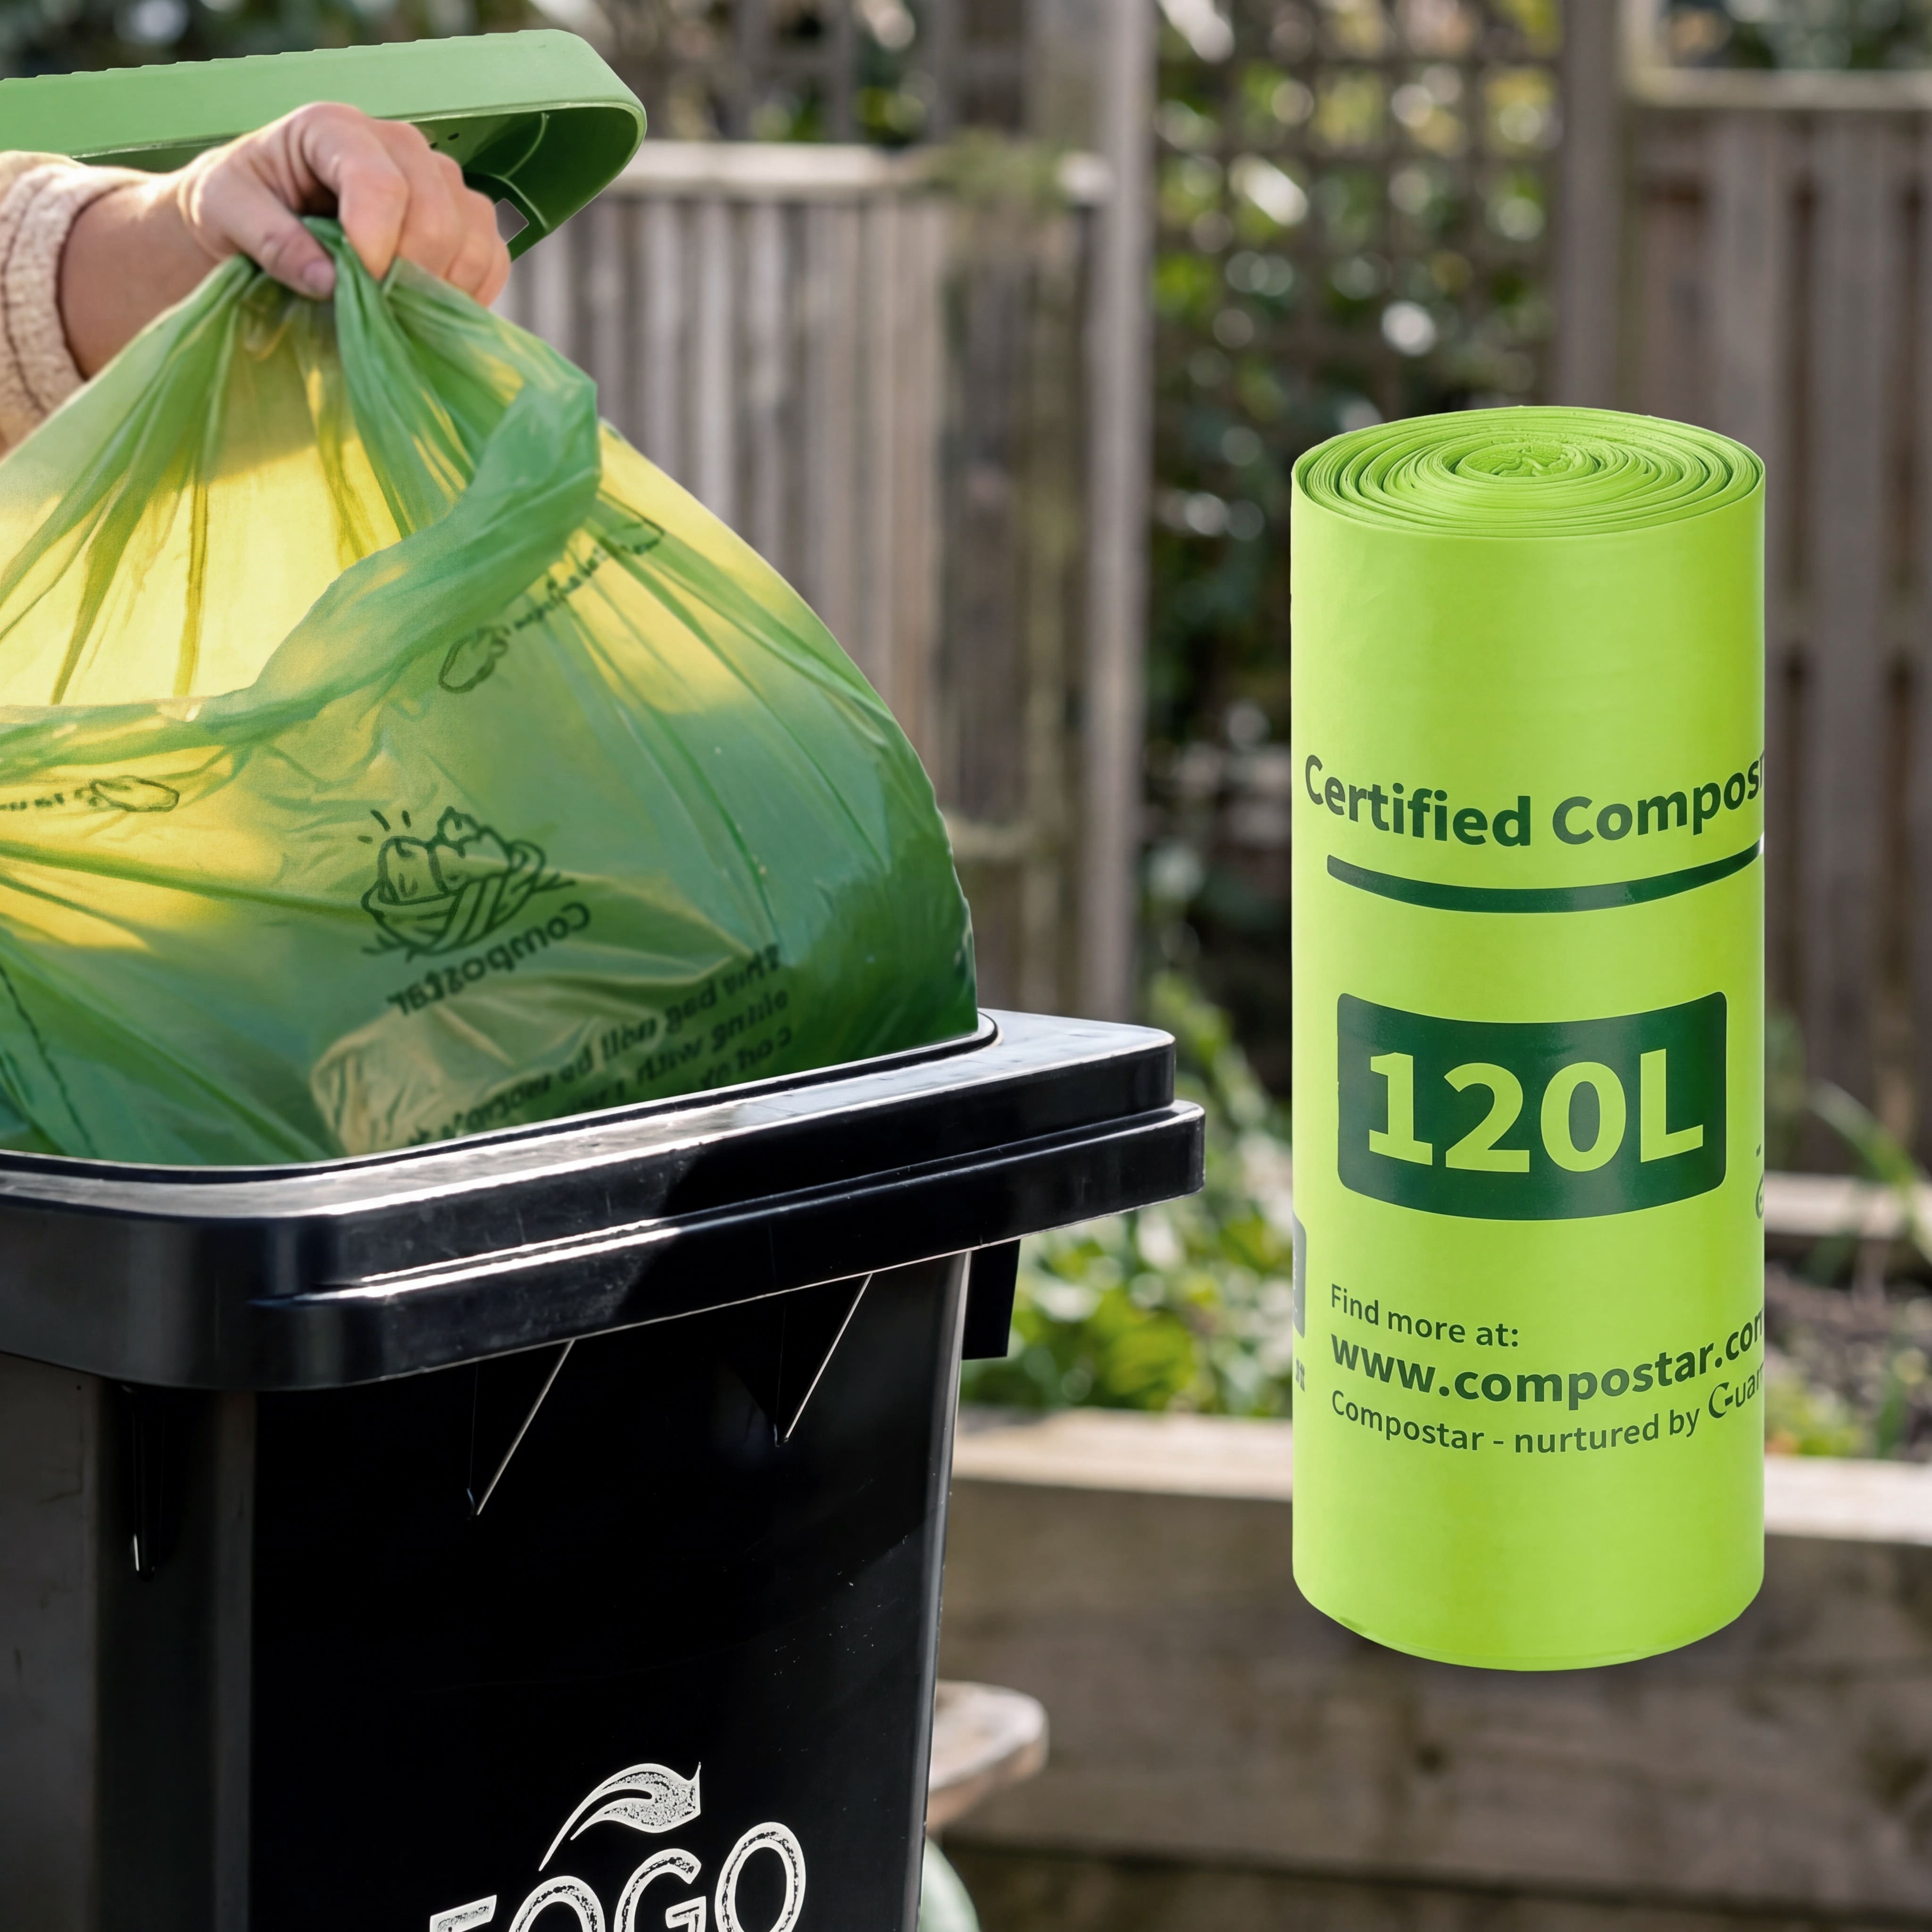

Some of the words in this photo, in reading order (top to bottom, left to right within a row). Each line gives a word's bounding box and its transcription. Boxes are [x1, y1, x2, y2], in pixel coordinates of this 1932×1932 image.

[1305, 755, 1531, 847] Certified
[1368, 1048, 1703, 1173] 120L
[1332, 1283, 1379, 1326] Find
[1388, 1311, 1466, 1344] more
[1476, 1323, 1518, 1348] at:
[1332, 1390, 1485, 1451] Compostar
[1515, 1412, 1659, 1453] nurtured
[1669, 1407, 1700, 1439] by
